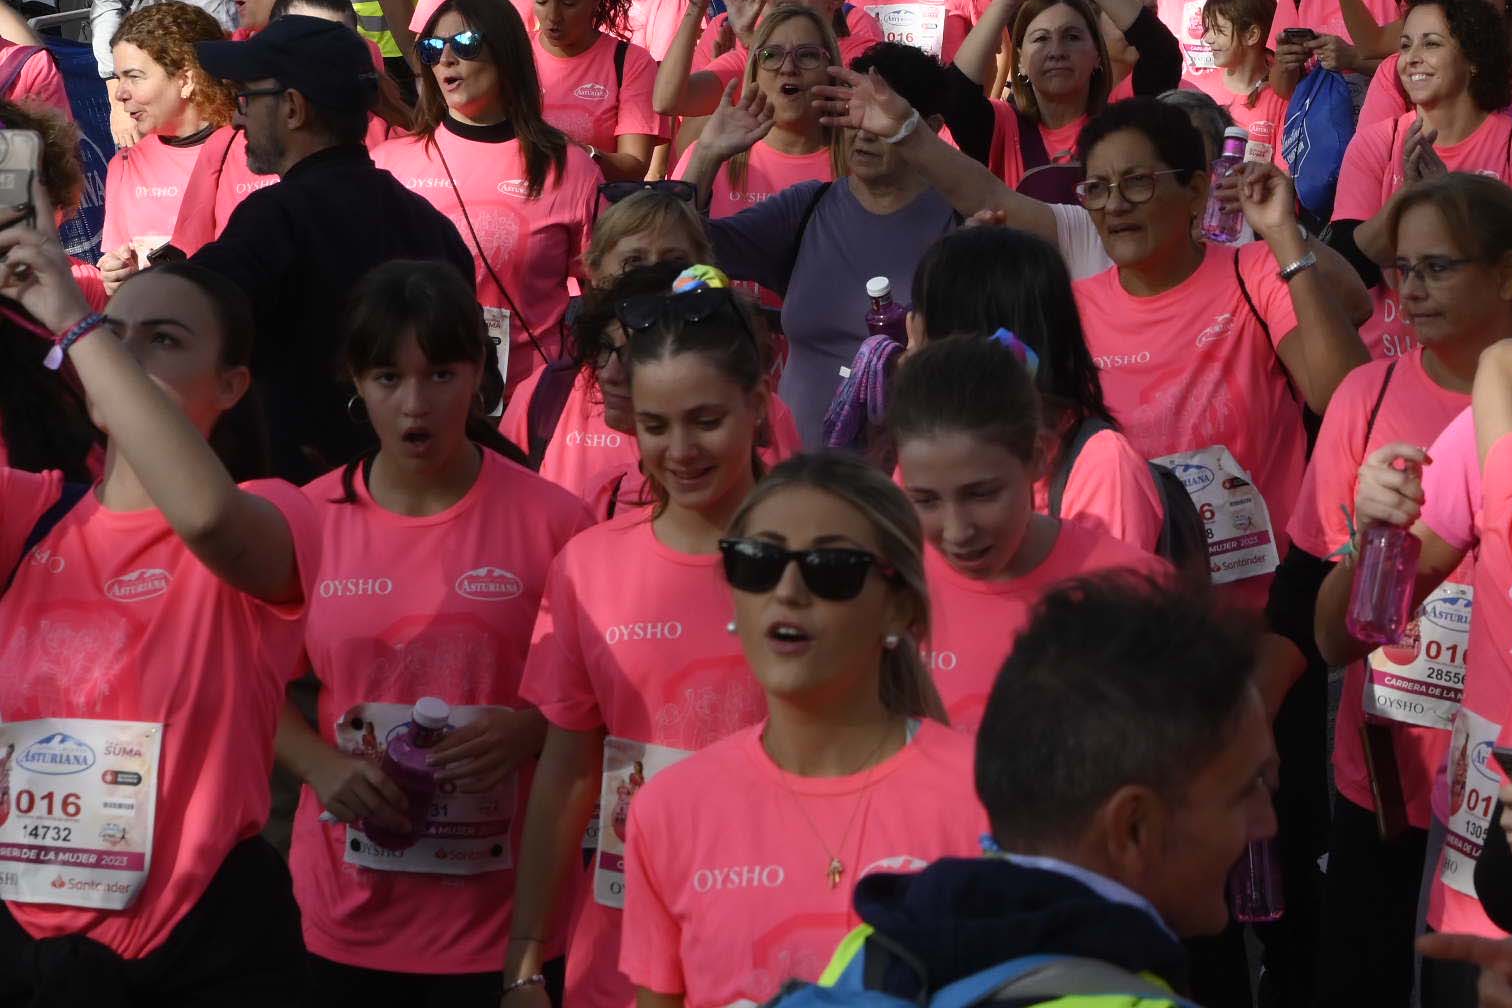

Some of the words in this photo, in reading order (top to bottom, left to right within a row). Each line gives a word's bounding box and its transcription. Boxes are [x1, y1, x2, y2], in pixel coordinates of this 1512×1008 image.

[887, 32, 914, 43] 016
[566, 430, 621, 449] OYSHO
[1208, 542, 1238, 554] MUJER
[1222, 553, 1267, 571] Santander
[319, 577, 393, 598] OYSHO
[461, 579, 518, 593] ASTURIANA
[606, 621, 682, 645] OYSHO
[1384, 676, 1426, 692] CARRERA
[1428, 686, 1441, 696] DE
[1443, 689, 1455, 698] LA
[1377, 694, 1424, 714] OYSHO
[21, 750, 89, 766] ASTURIANA
[104, 745, 142, 758] SUMA
[15, 789, 82, 818] 016
[22, 849, 36, 859] DE
[40, 850, 55, 861] LA
[58, 852, 98, 864] MUJER
[101, 855, 128, 866] 2023
[694, 865, 784, 893] OYSHO
